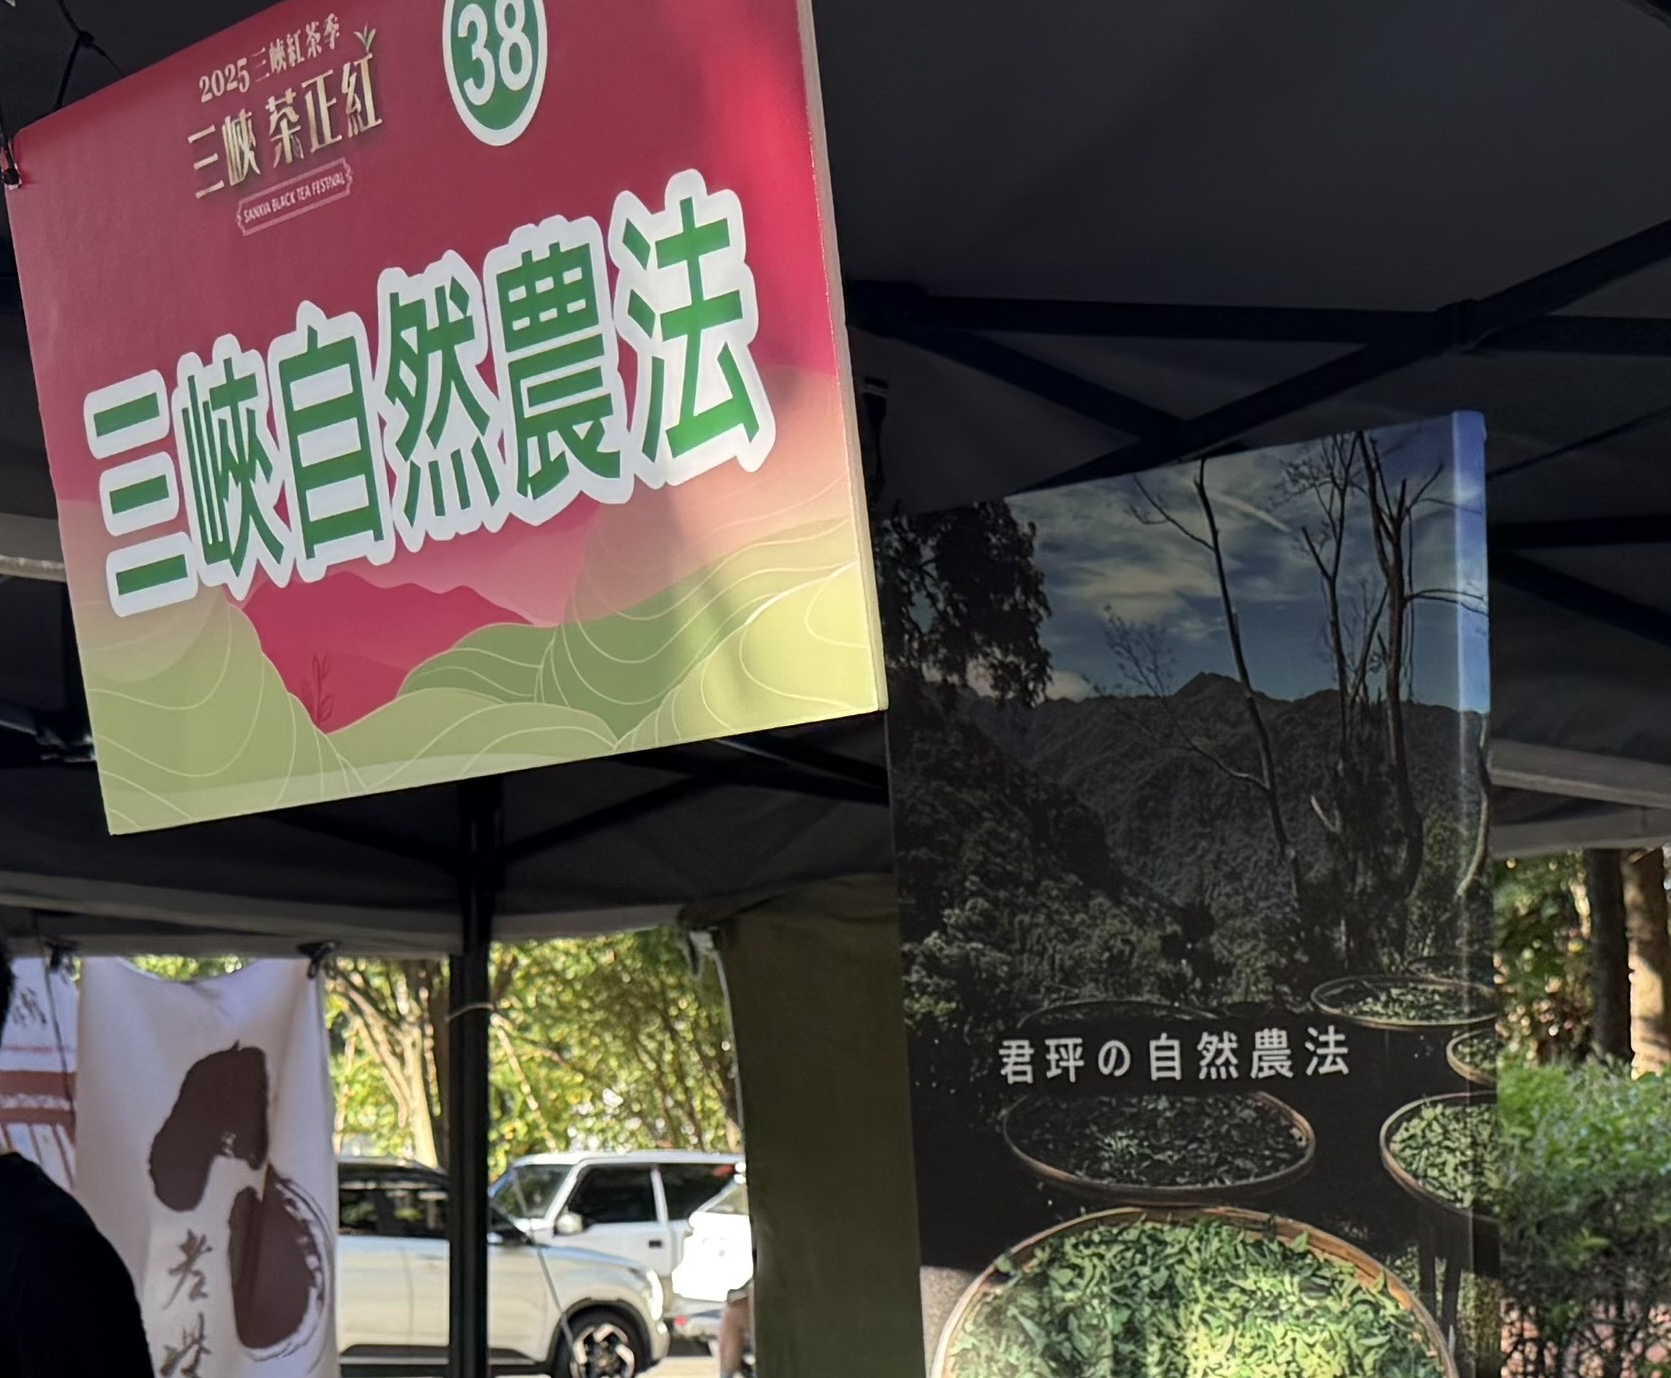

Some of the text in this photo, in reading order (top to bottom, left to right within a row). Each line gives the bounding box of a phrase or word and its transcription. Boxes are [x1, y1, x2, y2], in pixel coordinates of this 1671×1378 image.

[456, 0, 534, 107] 38
[187, 52, 384, 200] 三峽 茶正紅
[271, 190, 296, 213] BLACK
[296, 183, 313, 204] TEA
[312, 171, 346, 198] FESTIVAL
[86, 174, 772, 612] 三峽自然農法
